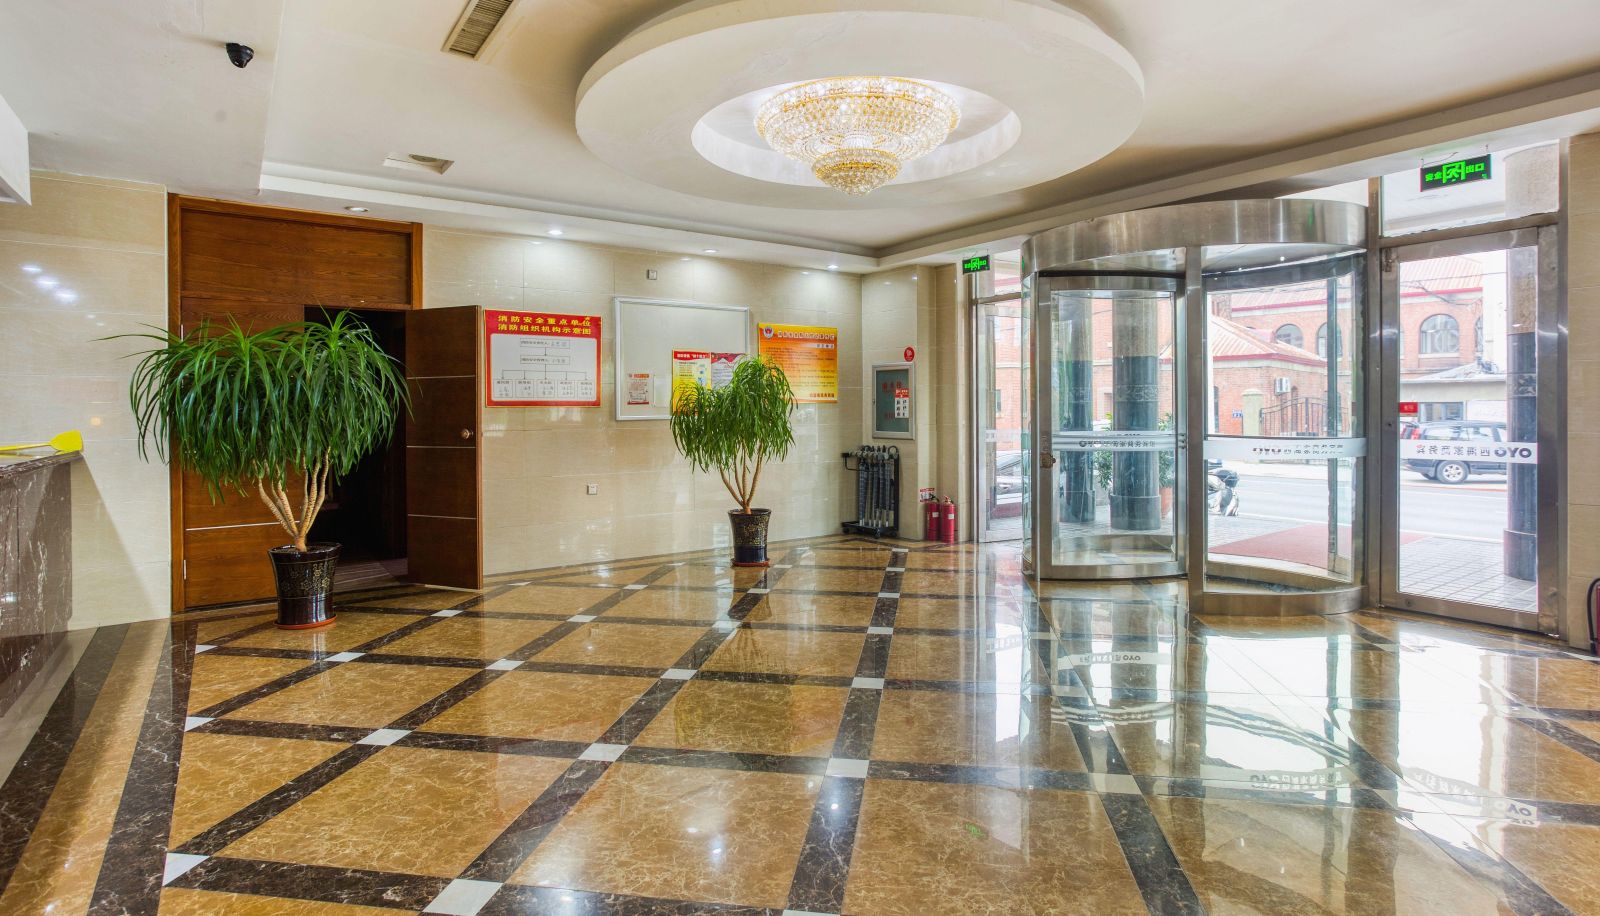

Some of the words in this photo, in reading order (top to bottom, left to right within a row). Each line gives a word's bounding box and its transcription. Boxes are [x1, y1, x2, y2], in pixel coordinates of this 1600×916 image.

[1425, 171, 1443, 182] 安全
[1466, 162, 1485, 173] 出口
[497, 315, 592, 327] 消防安全重点单位
[497, 323, 592, 335] 消防组织机构示意图
